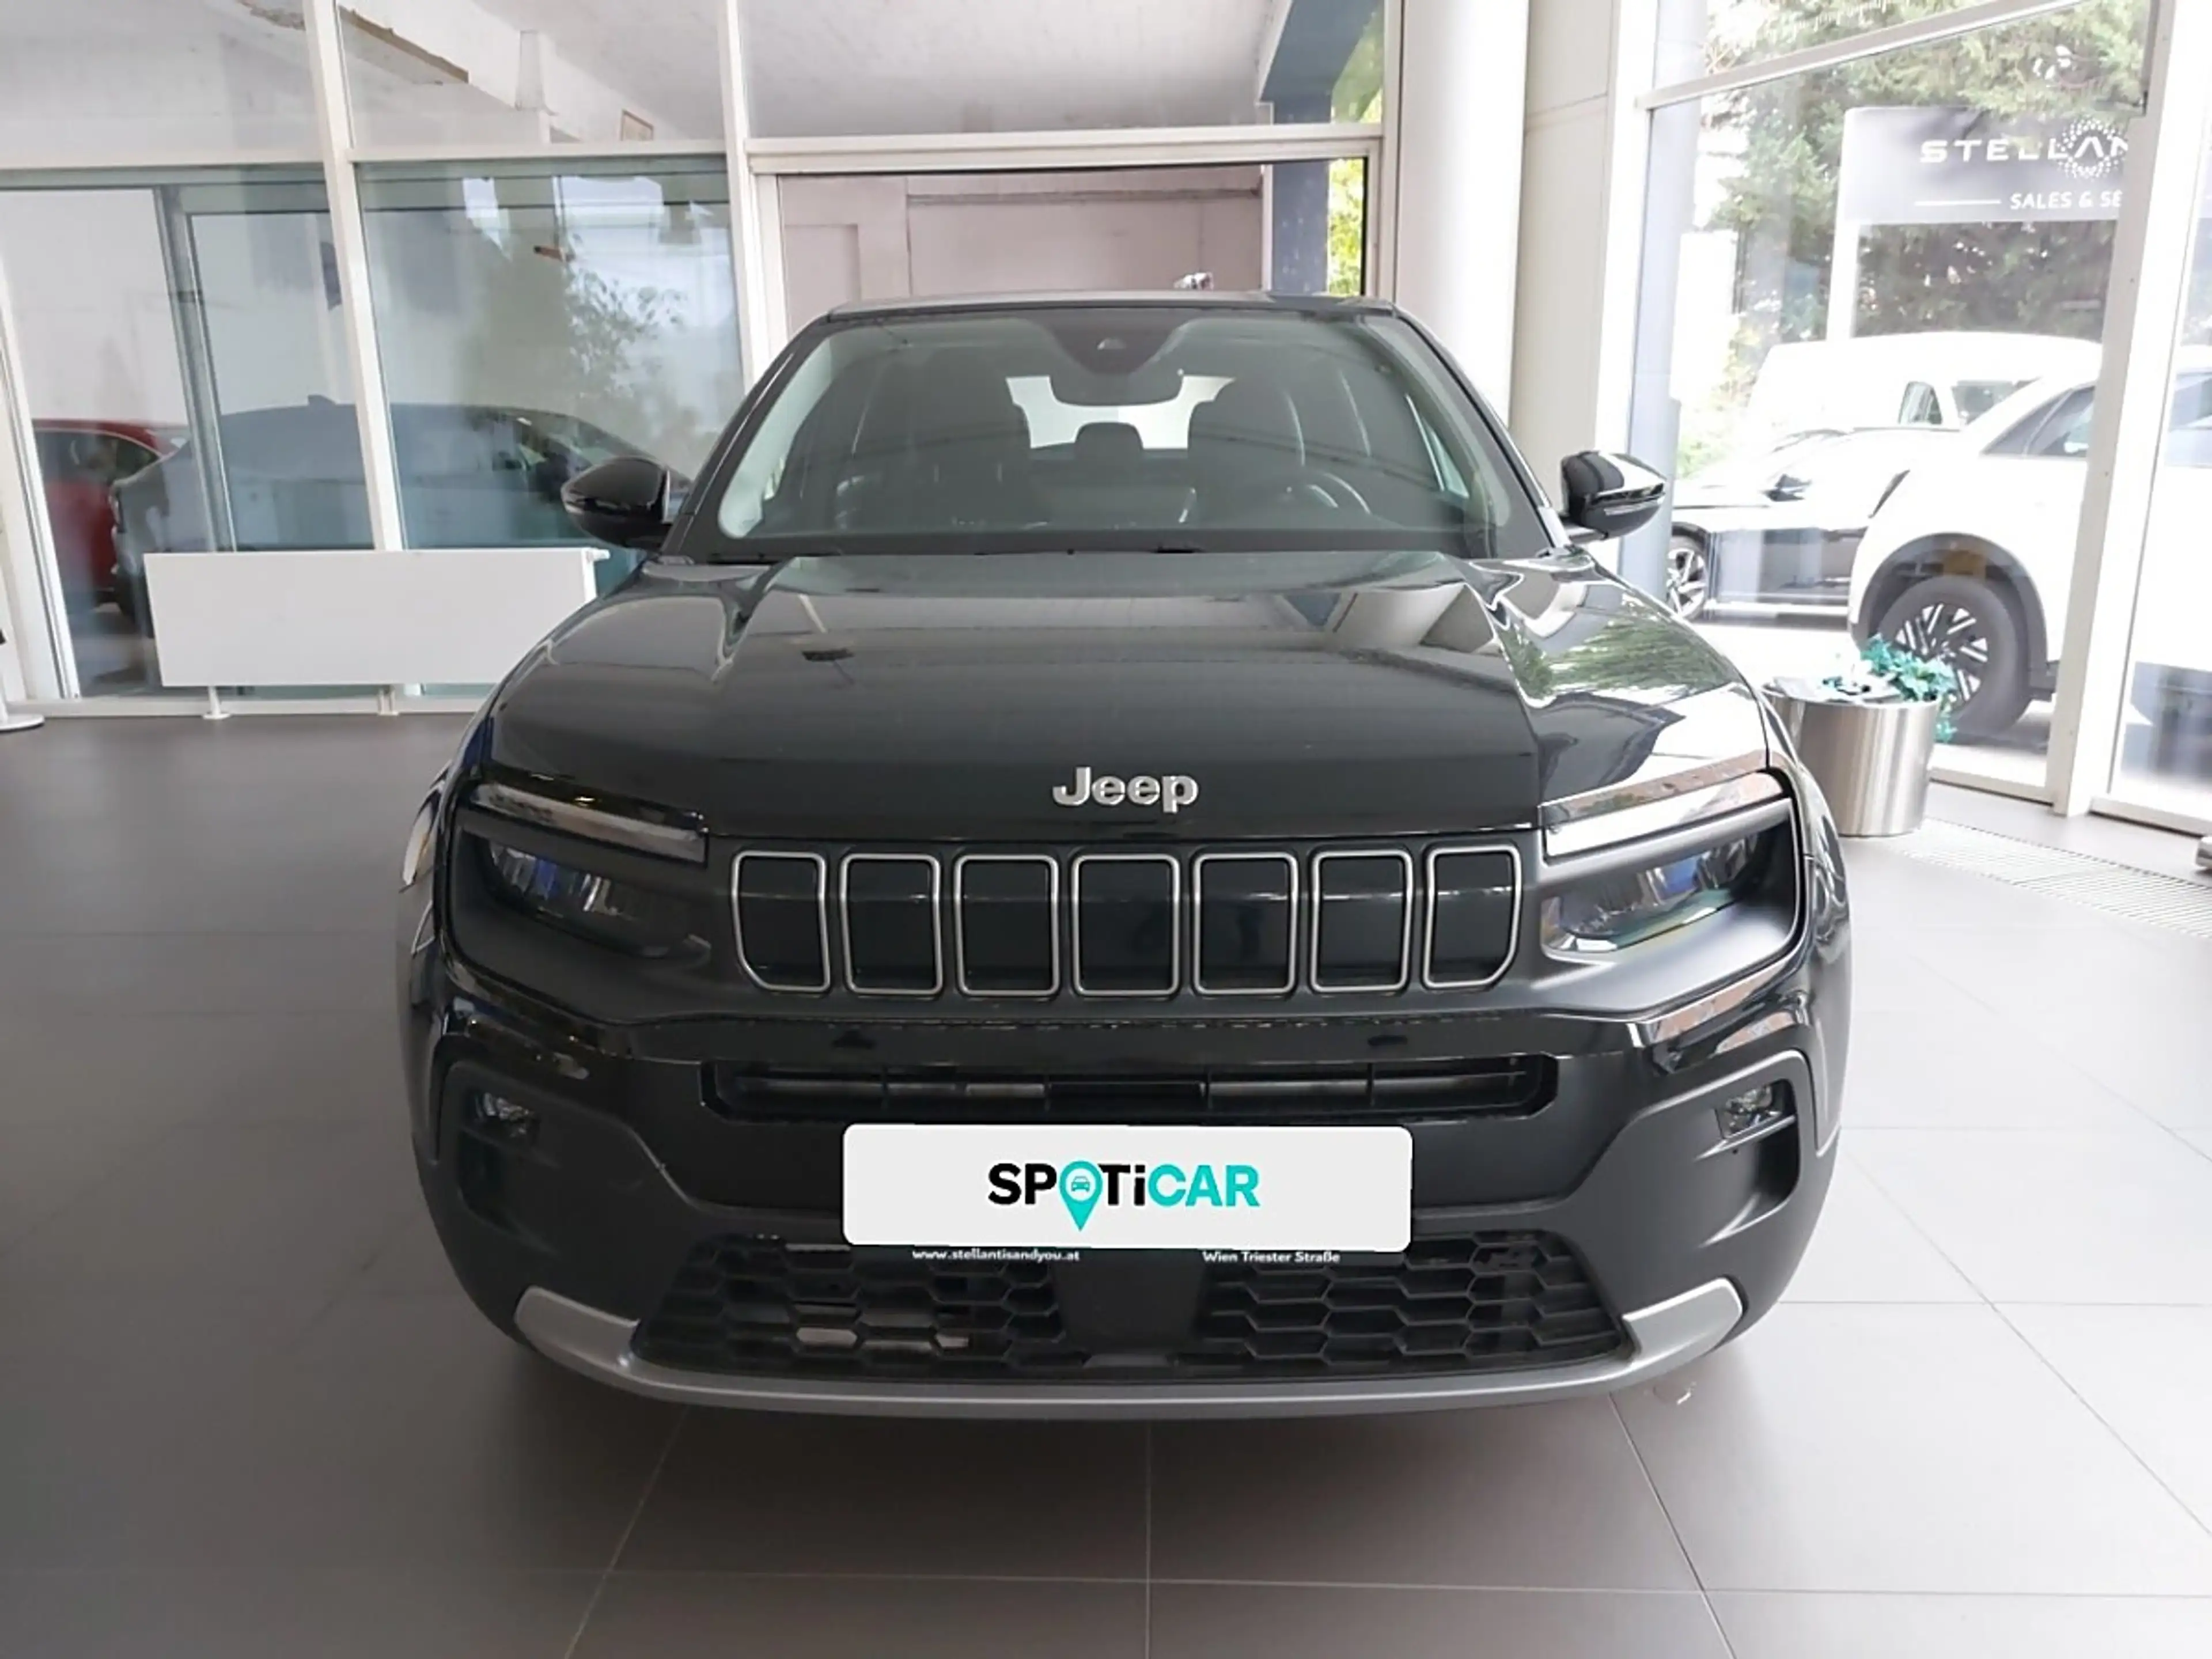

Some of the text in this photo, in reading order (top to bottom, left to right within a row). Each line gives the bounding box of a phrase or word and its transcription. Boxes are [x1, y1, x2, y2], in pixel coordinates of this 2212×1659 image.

[2009, 192, 2073, 210] SALES
[2078, 191, 2094, 208] &
[1052, 766, 1199, 813] Jeep
[912, 1247, 1080, 1263] www.stellantisandyou.at
[1202, 1251, 1341, 1263] Wien Triester Straße
